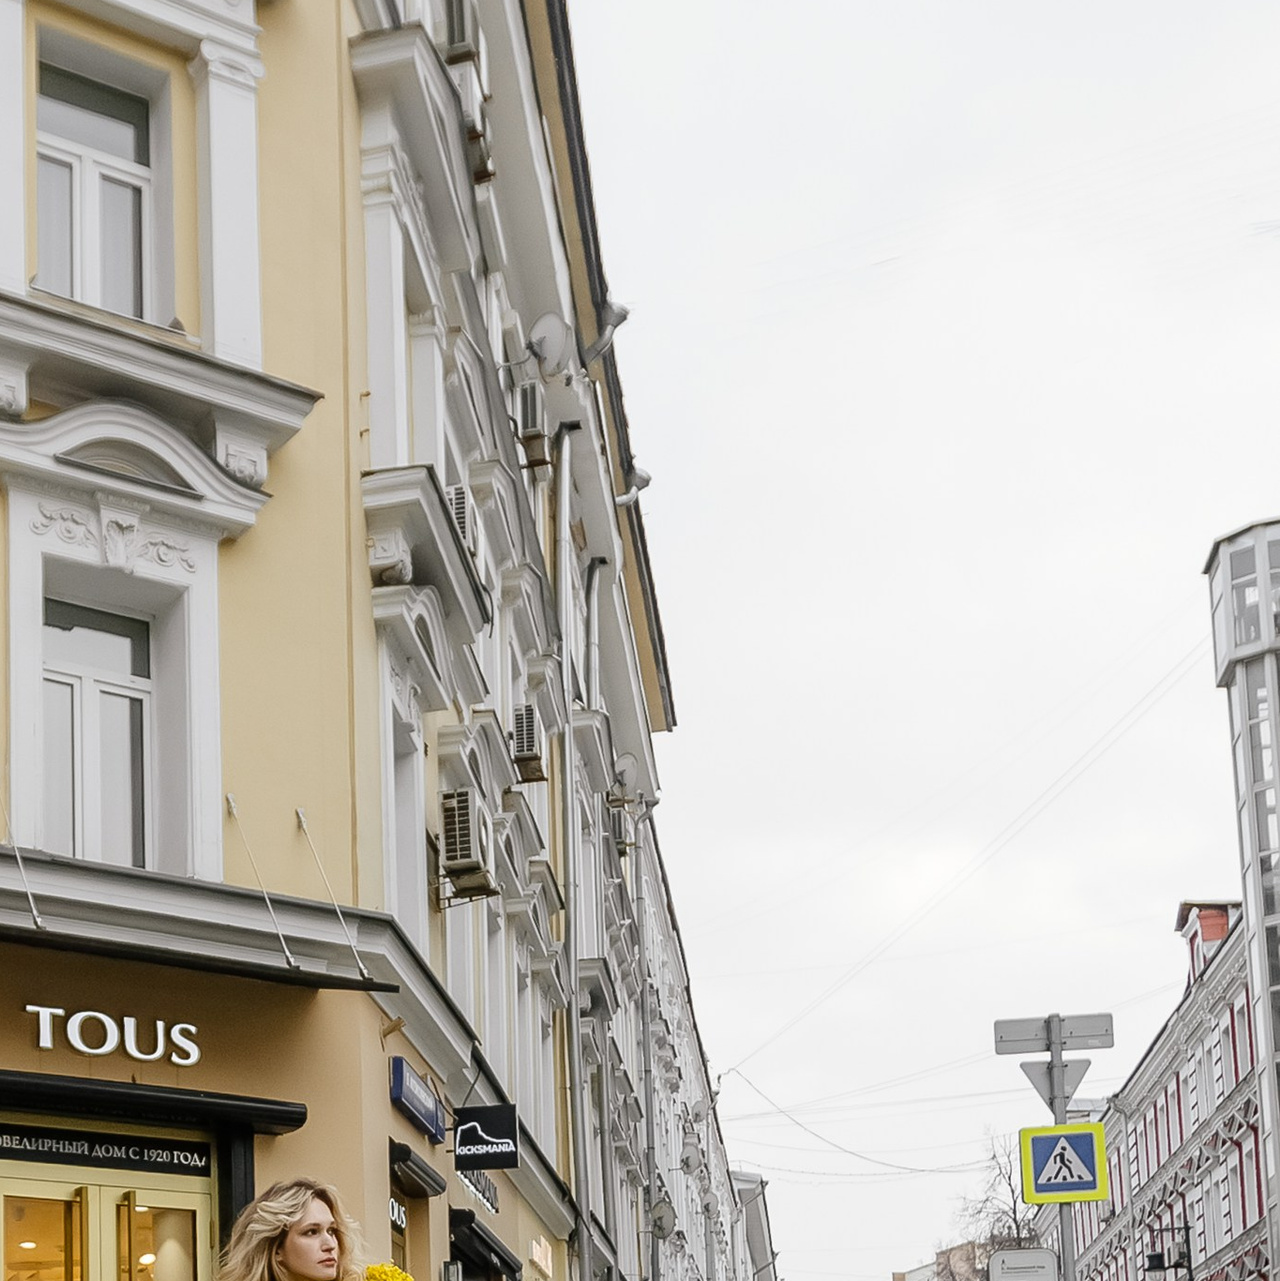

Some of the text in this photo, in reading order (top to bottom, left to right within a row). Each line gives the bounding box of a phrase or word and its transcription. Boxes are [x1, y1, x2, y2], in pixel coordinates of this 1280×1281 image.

[25, 1004, 201, 1067] TOUS
[91, 1144, 127, 1159] ДОМ
[143, 1148, 170, 1162] 1920
[455, 1142, 516, 1155] KICKSMANIA
[389, 1197, 407, 1229] OUS
